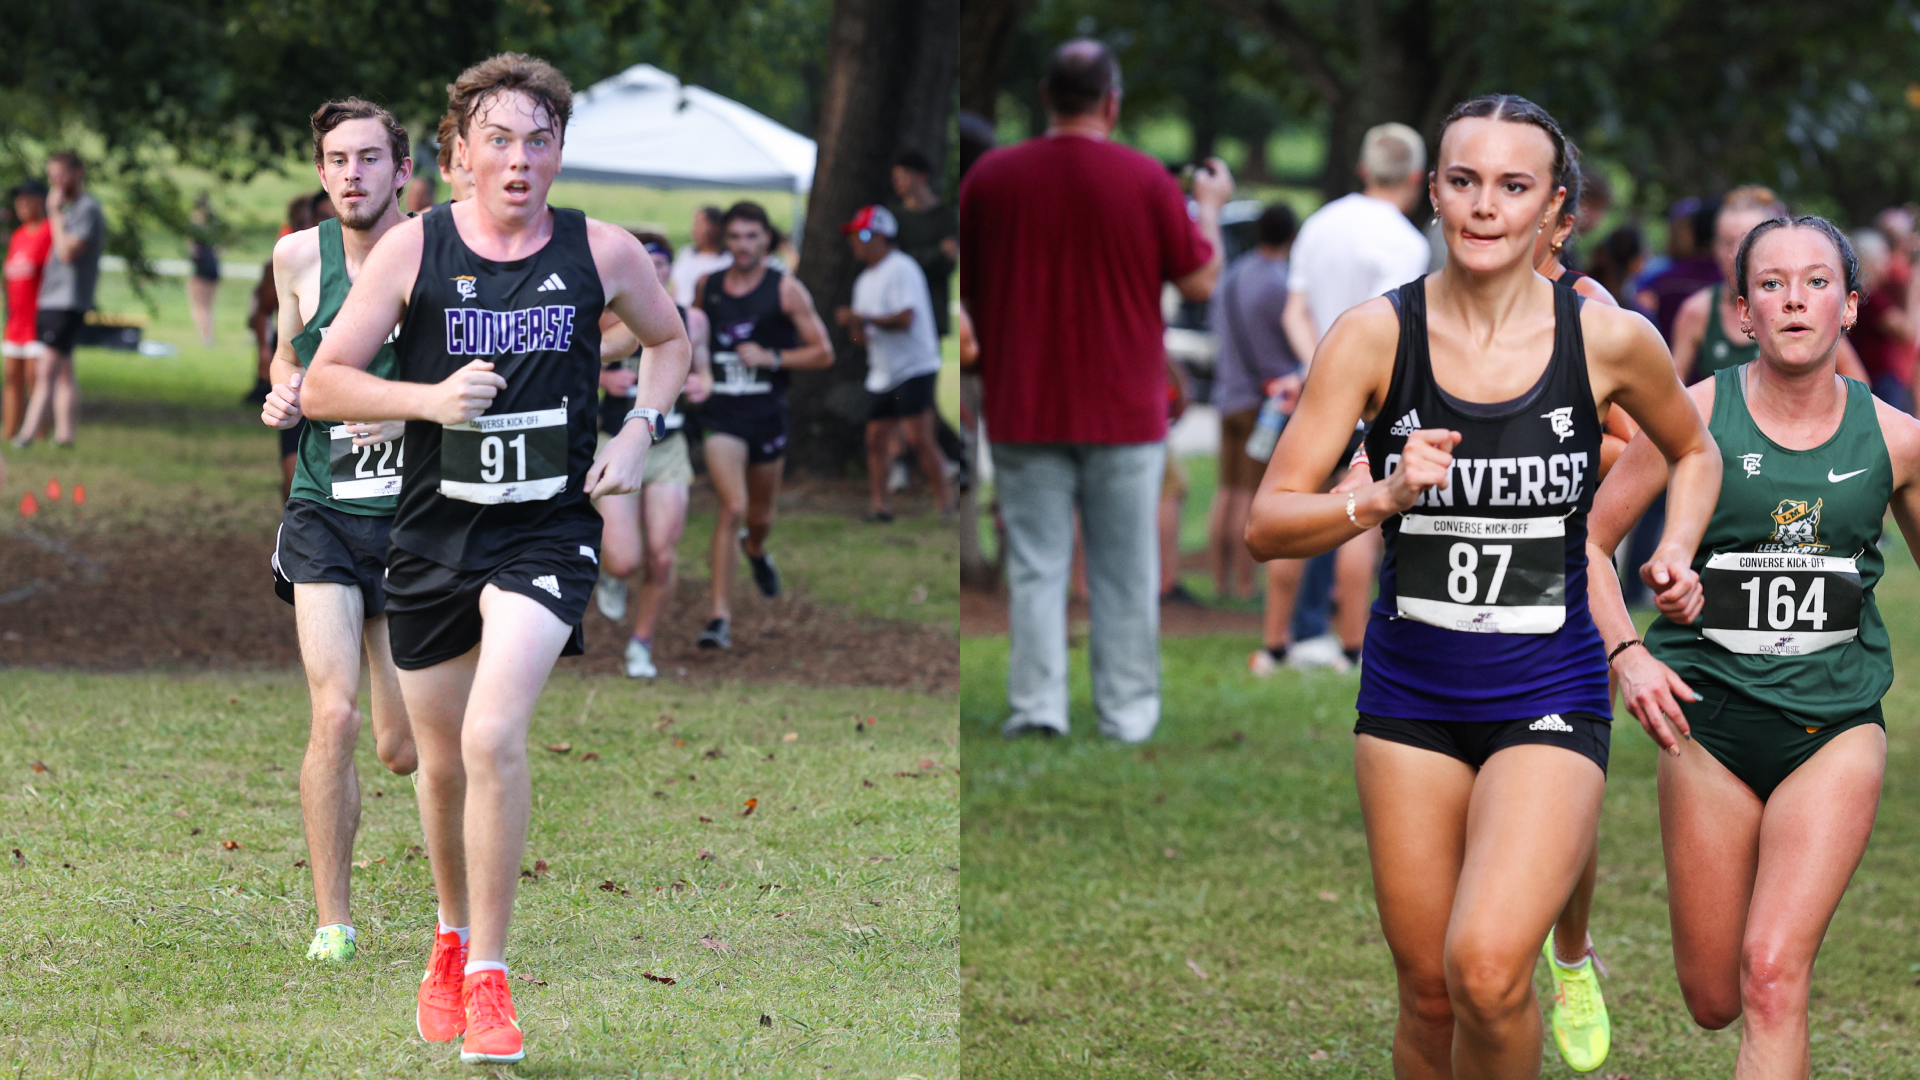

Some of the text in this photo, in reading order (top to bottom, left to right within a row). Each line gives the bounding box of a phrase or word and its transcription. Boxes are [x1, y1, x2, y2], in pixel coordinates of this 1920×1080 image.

[444, 305, 576, 355] CONVERSE
[506, 415, 539, 428] KICK-OFF
[1390, 425, 1420, 437] adid
[480, 434, 526, 483] 91
[1434, 520, 1529, 535] CONVERSE KICK-OFF
[1739, 557, 1826, 569] CONVERSE KICK-OFF
[1447, 542, 1513, 604] 87
[1740, 576, 1828, 630] 164
[1759, 644, 1800, 653] CONVERSE
[1529, 722, 1574, 732] adidas
